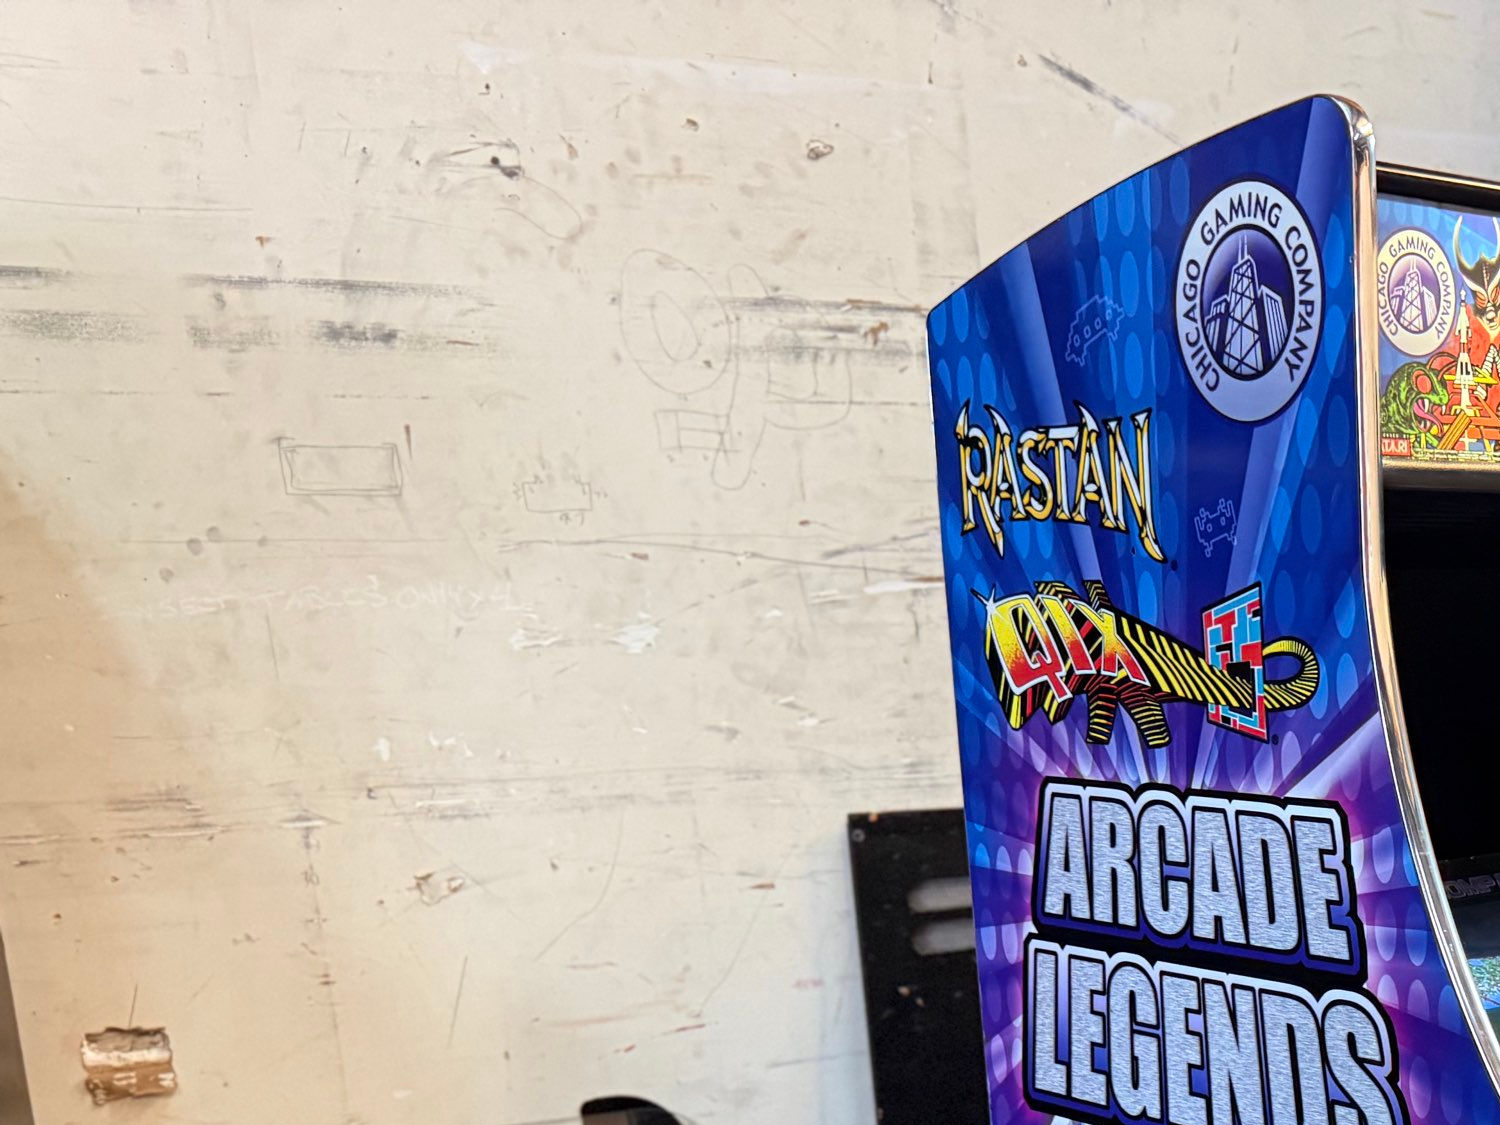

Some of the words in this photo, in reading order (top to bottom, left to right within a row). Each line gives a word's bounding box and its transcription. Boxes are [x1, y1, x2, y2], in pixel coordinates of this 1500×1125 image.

[1200, 190, 1284, 247] GAMING
[1184, 256, 1221, 393] CHICAGO
[1284, 222, 1316, 384] COMPANY
[1378, 262, 1399, 337] CHICAGO
[1389, 236, 1436, 259] GAMING
[1436, 261, 1453, 341] COMPANY
[952, 401, 1168, 563] RASTAN
[985, 593, 1151, 704] QIX
[1040, 780, 1360, 970] ARCADE
